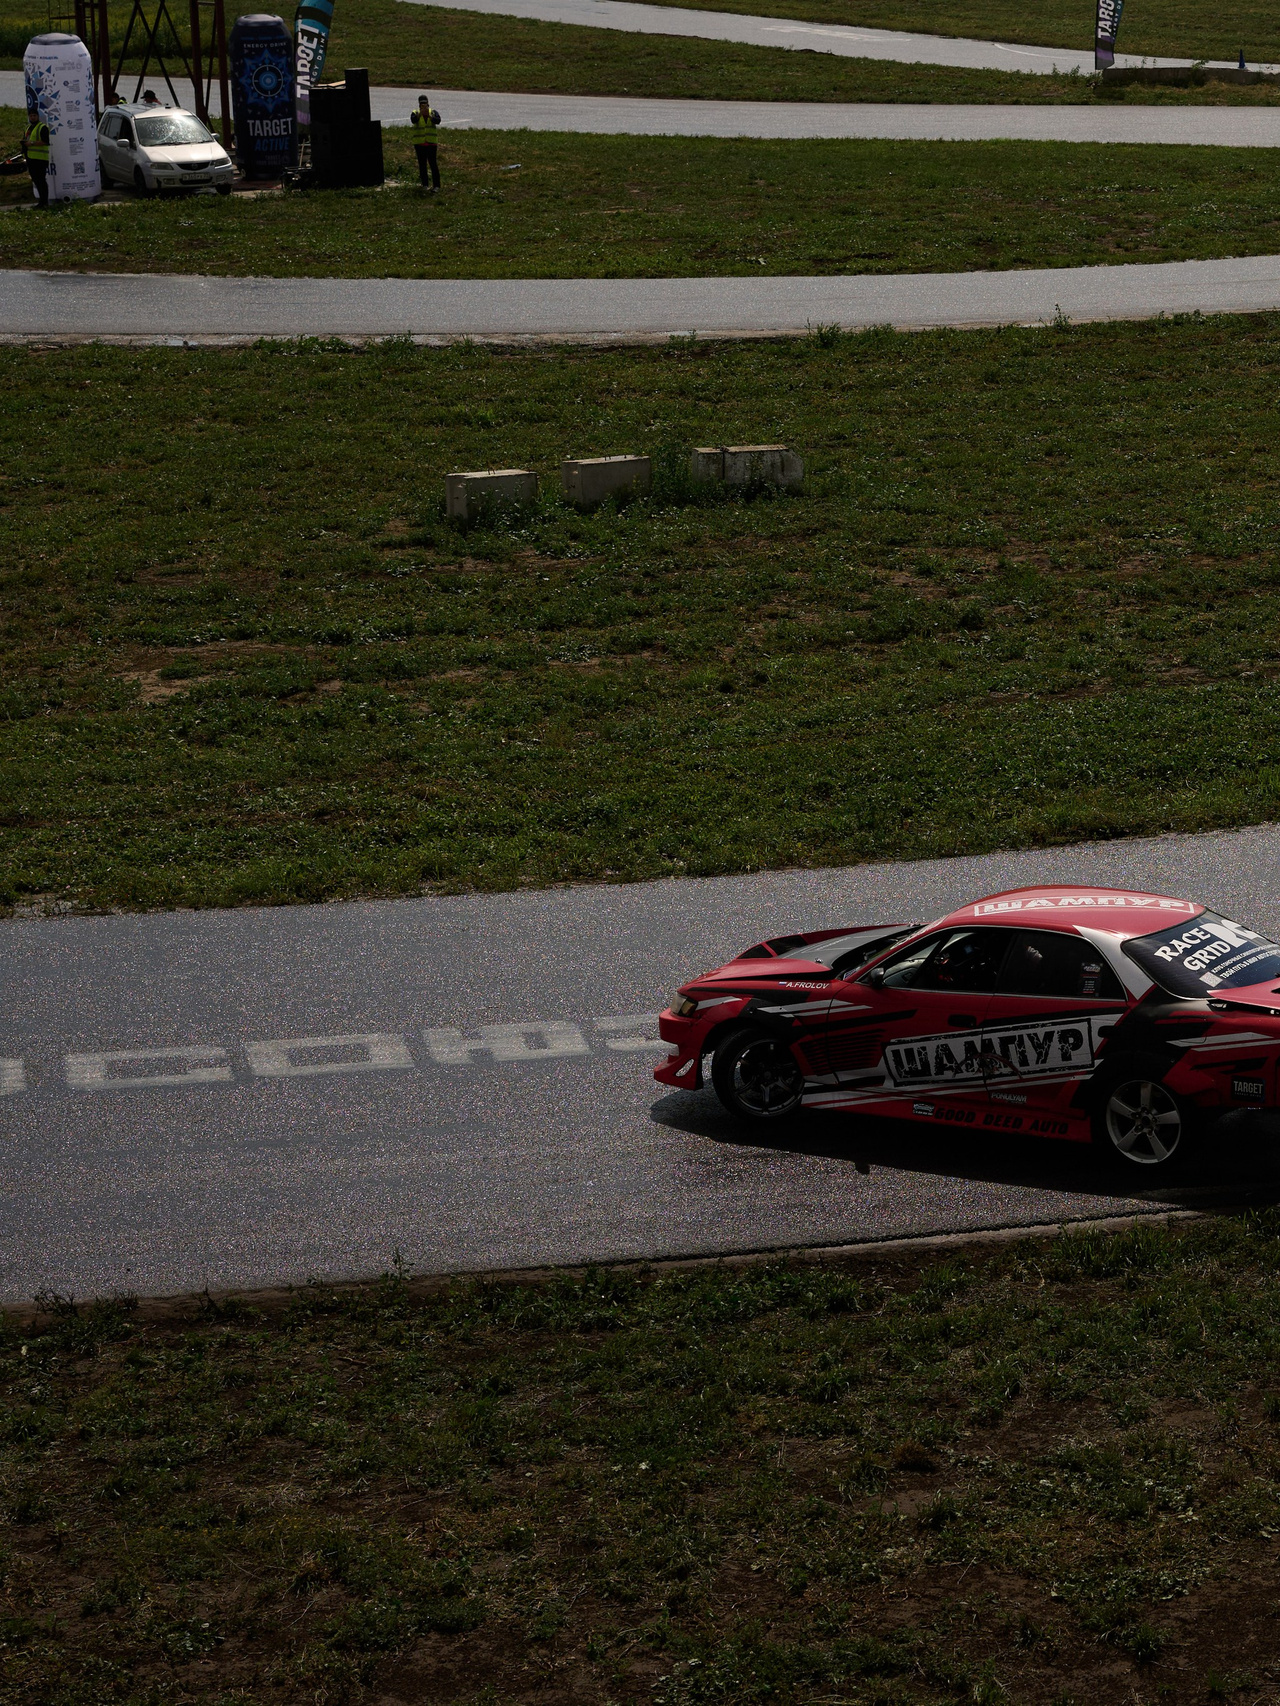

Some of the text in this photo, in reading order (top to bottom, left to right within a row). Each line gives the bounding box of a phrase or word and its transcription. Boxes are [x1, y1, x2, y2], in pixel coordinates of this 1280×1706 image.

[1098, 0, 1115, 39] TARG
[296, 23, 320, 98] TARGET
[317, 31, 327, 61] DRINK
[247, 117, 293, 136] TARGET
[254, 137, 290, 152] ACTIVE
[984, 896, 1185, 913] ШАМПУР
[1154, 928, 1211, 962] RACE
[1183, 940, 1231, 971] GRID
[891, 1028, 1084, 1079] ШАМПУР
[1233, 1080, 1264, 1095] TARGET
[935, 1107, 976, 1123] GOOD
[982, 1113, 1023, 1130] DEED
[1029, 1119, 1069, 1135] AUTO
